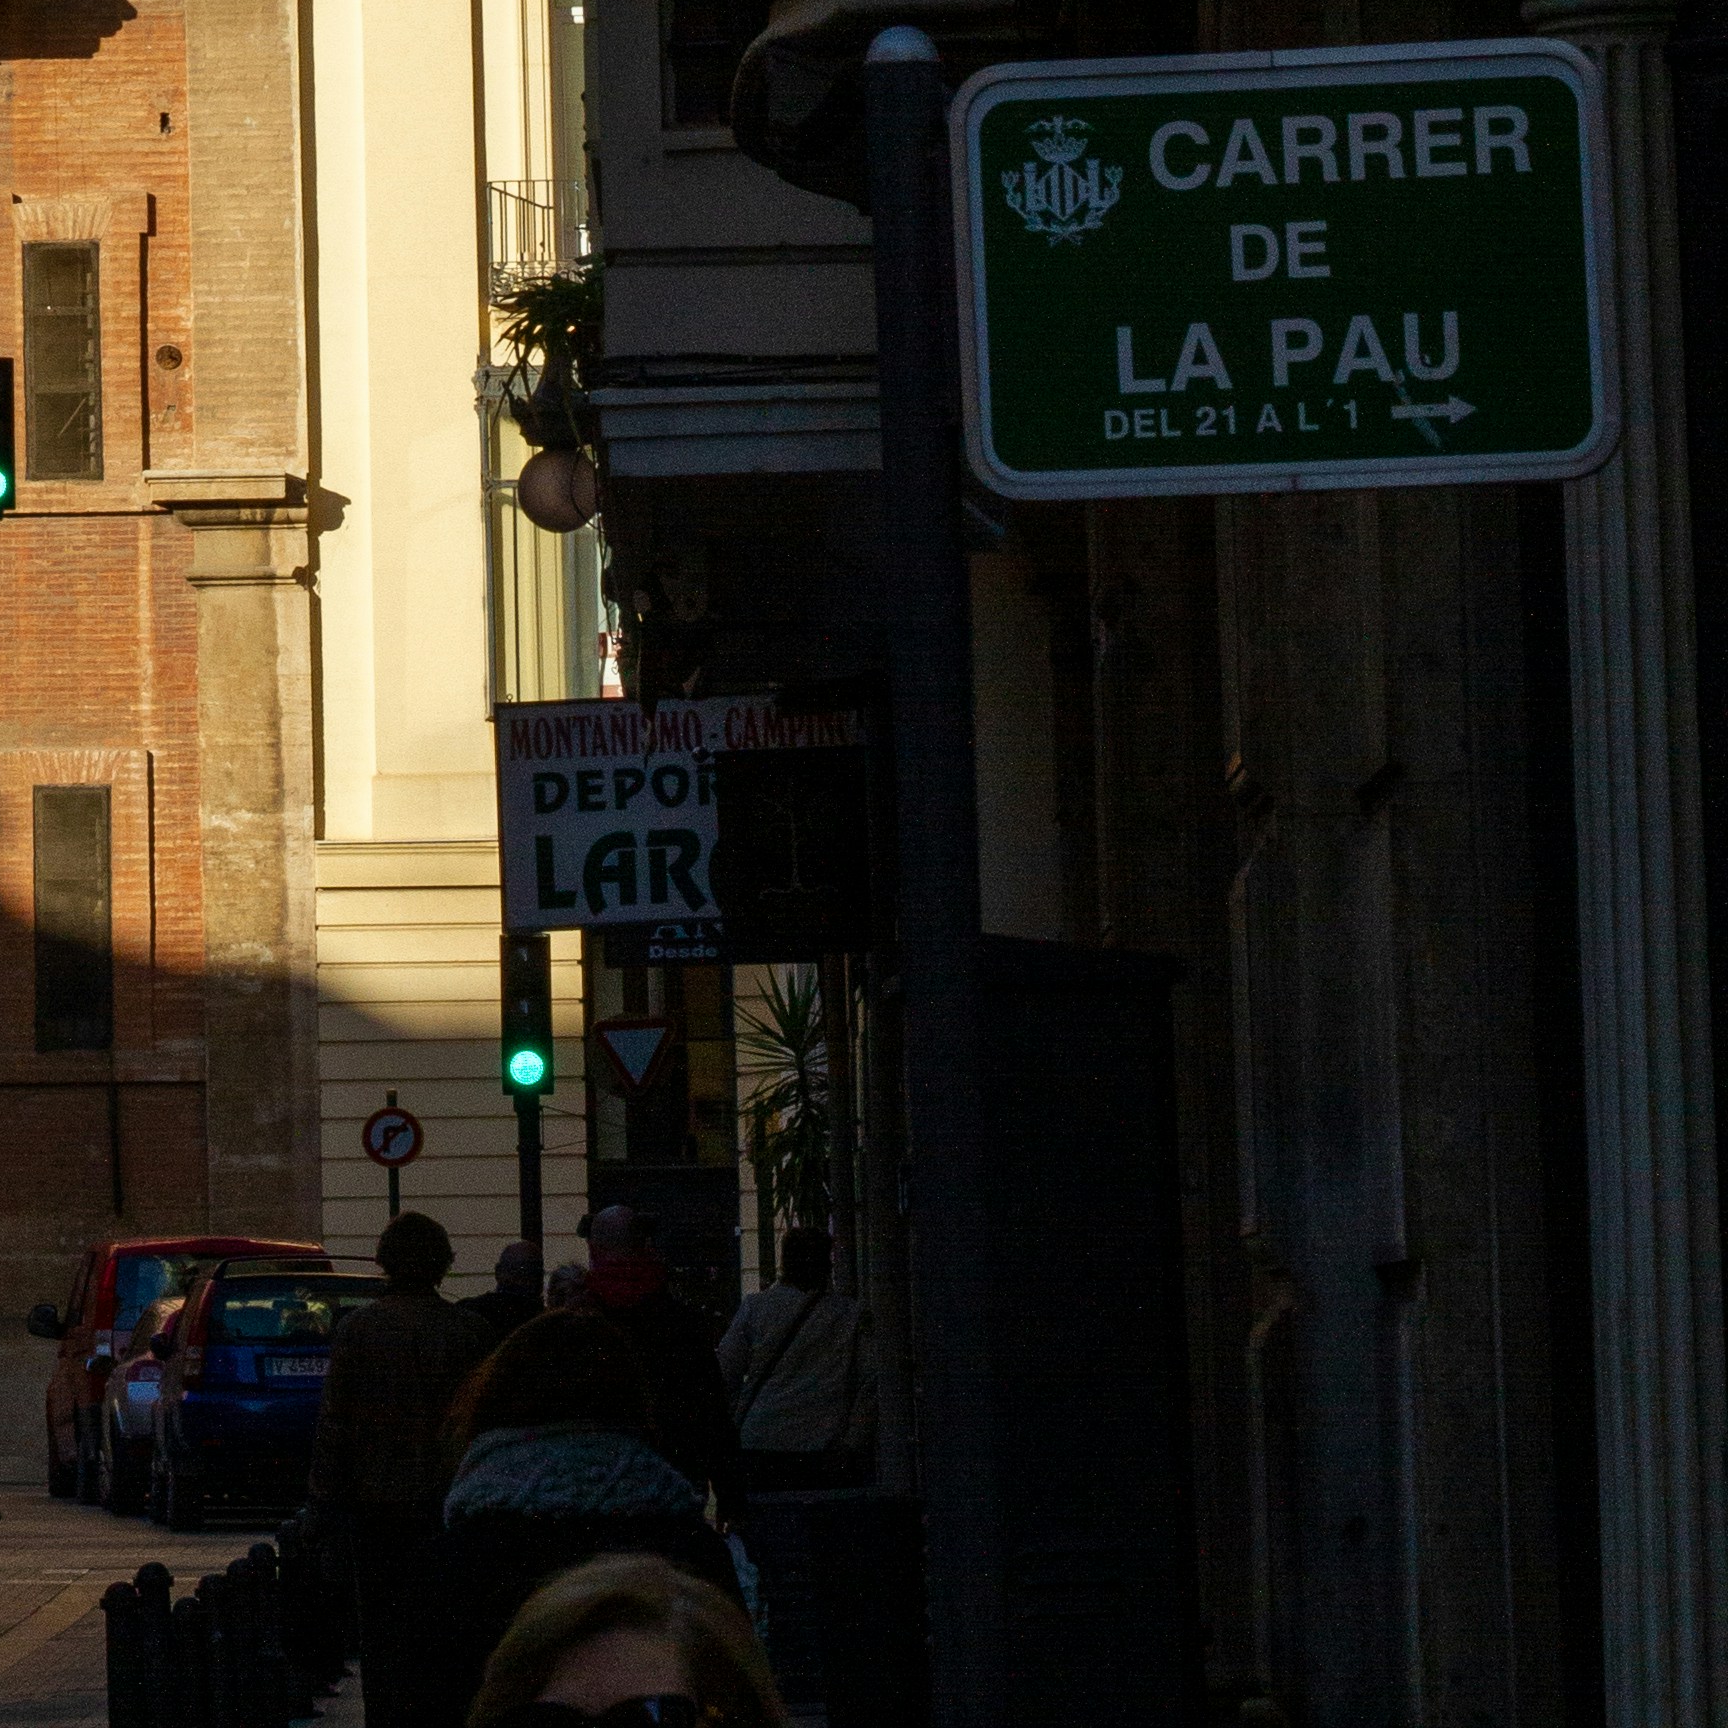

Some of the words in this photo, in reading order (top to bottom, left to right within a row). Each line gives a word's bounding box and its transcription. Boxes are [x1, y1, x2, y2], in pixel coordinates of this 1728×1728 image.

[1148, 104, 1533, 191] CARRER
[1229, 220, 1331, 281] DE
[1115, 322, 1233, 395] LA
[1270, 310, 1461, 388] PAU
[1103, 405, 1182, 440] DEL
[1195, 405, 1237, 436] 21
[1254, 403, 1284, 433] A
[535, 828, 720, 916] LAR
[648, 944, 720, 959] Desde
